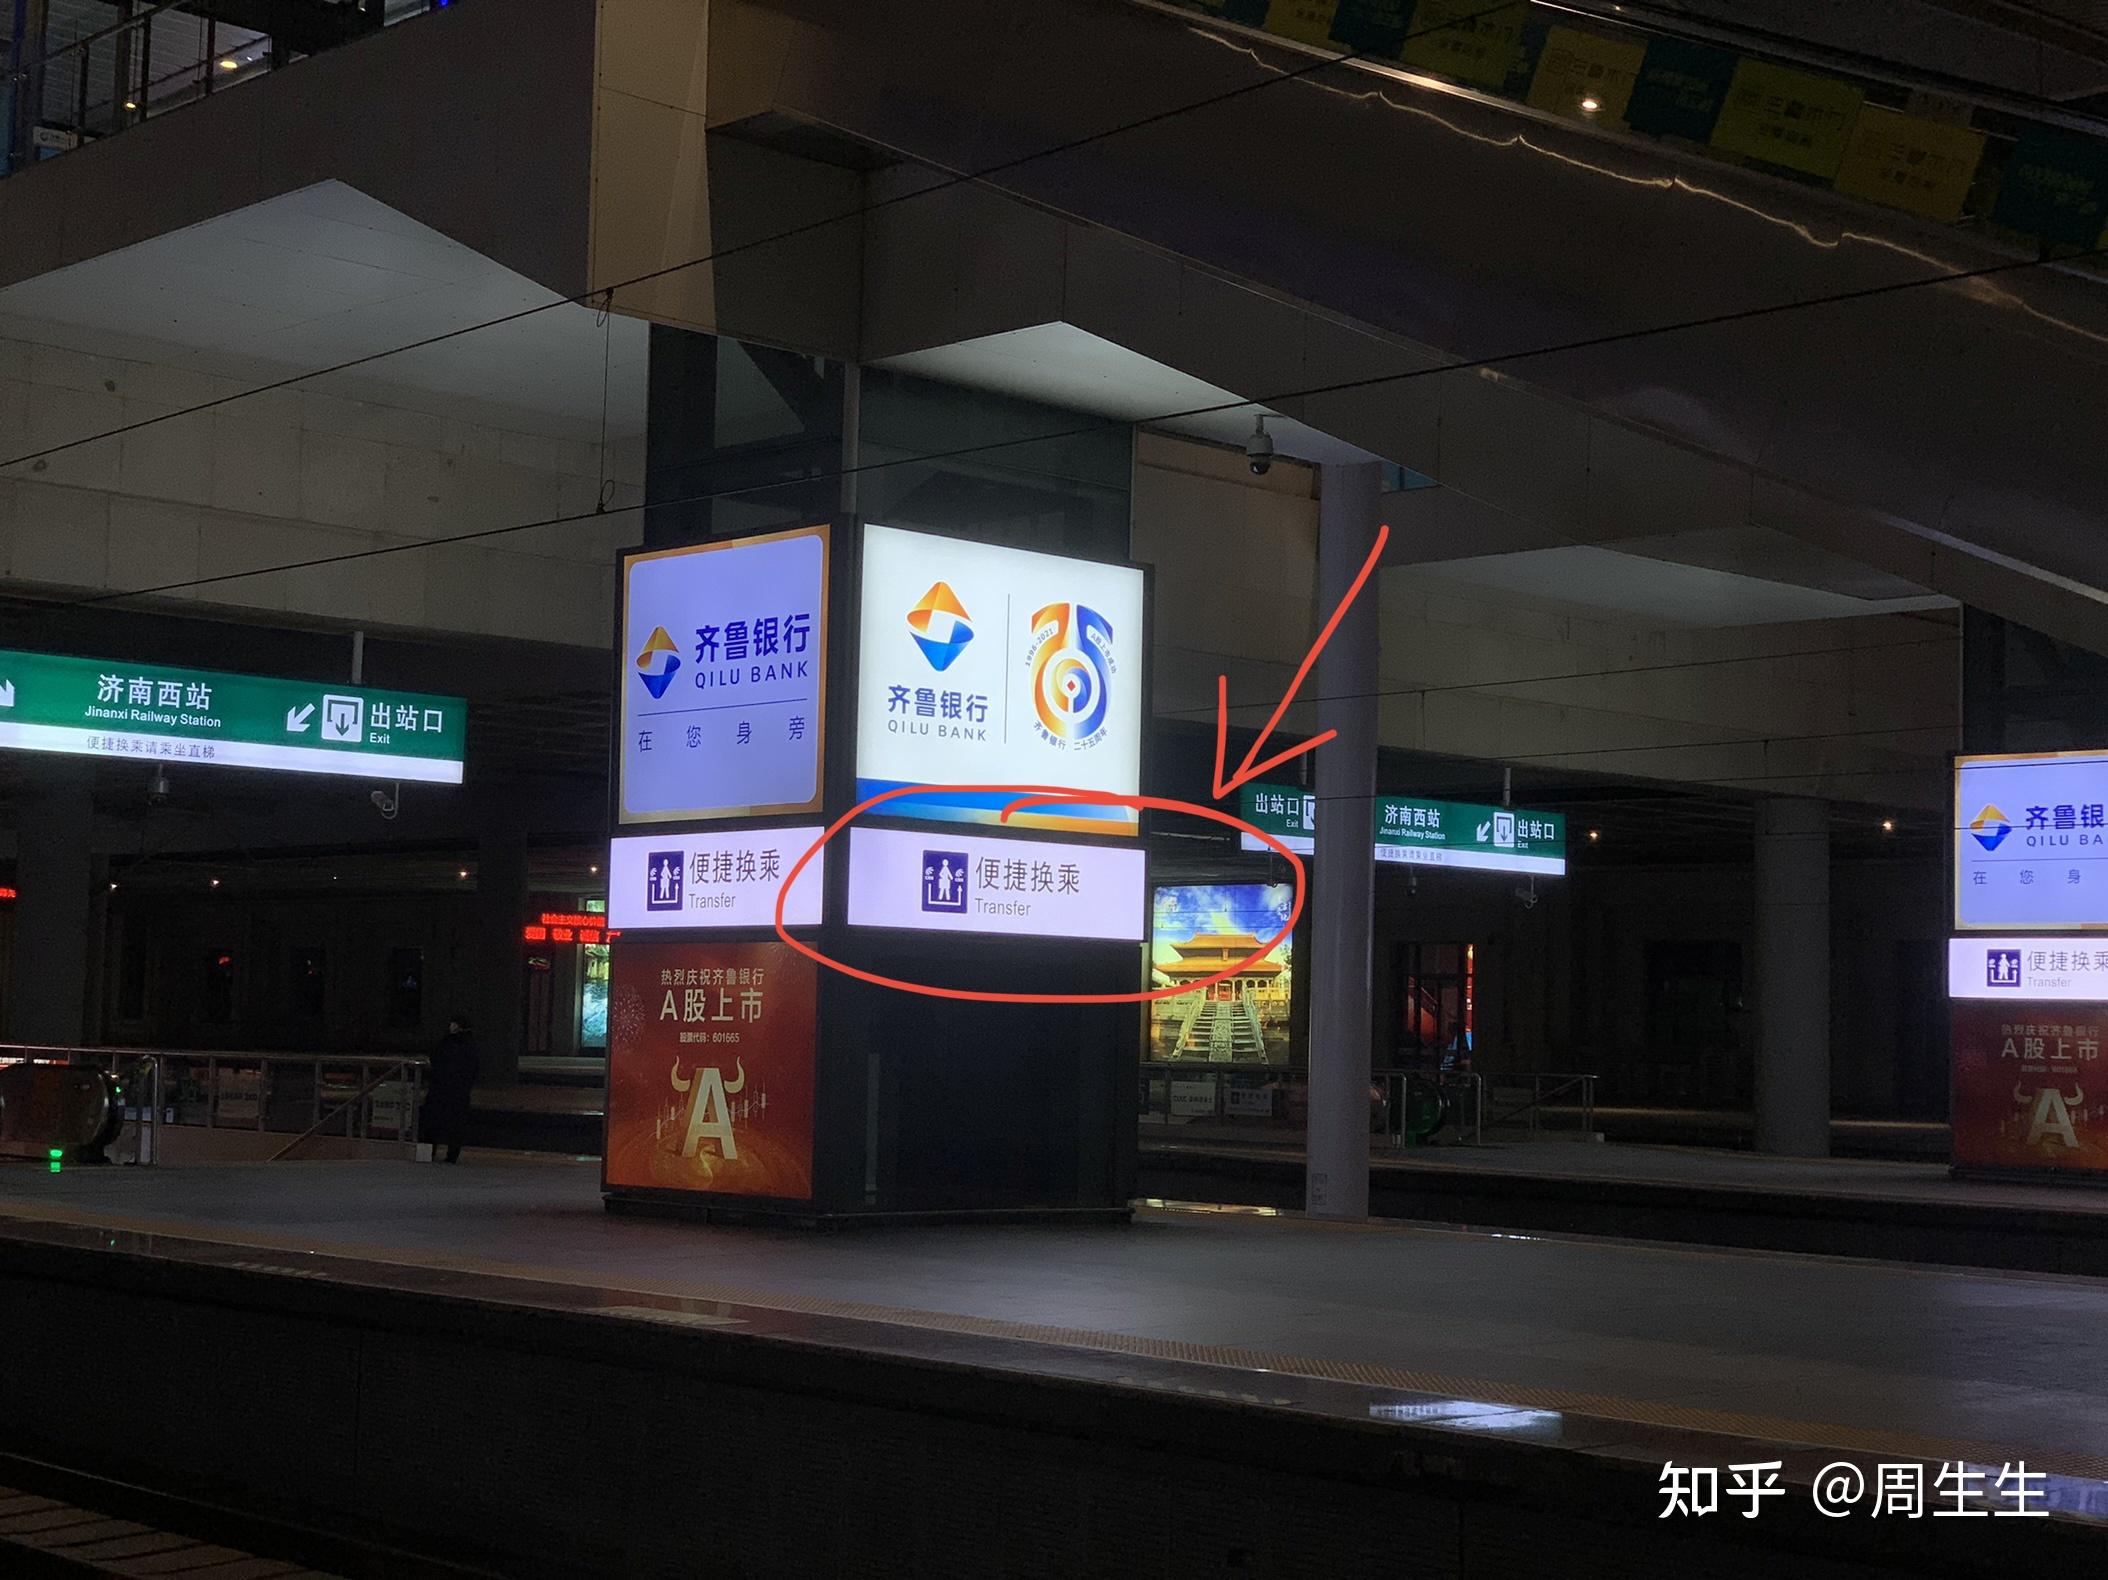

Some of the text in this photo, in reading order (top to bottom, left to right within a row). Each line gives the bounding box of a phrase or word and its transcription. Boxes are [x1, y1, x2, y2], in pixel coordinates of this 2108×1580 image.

[695, 613, 811, 664] 齐鲁银行
[695, 660, 808, 689] QILU BANK
[97, 673, 213, 711] 济南西站
[888, 684, 988, 723] 齐鲁银行
[84, 705, 222, 728] Jinanxi Railway Station
[370, 702, 444, 733] 出站口
[369, 731, 391, 745] Exit
[887, 719, 987, 742] QILU BANK
[86, 735, 216, 760] 便捷换乘请乘坐直梯
[1255, 792, 1299, 816] 出站口
[1286, 818, 1299, 828] Exit
[1384, 804, 1441, 829] 济南西站
[2025, 803, 2104, 830] 齐鲁银
[1517, 818, 1555, 840] 出站口
[2026, 834, 2069, 847] QILU
[689, 848, 780, 883] 便捷换乘
[975, 856, 1080, 895] 便捷换乘
[688, 893, 735, 910] Transfer
[975, 898, 1031, 917] Transfer
[2026, 950, 2108, 972] 便捷换乘
[660, 967, 765, 986] 热烈庆祝齐鲁银行
[2026, 976, 2072, 988] Transfer
[659, 988, 764, 1024] A股上市
[2001, 1037, 2099, 1061] A股上市
